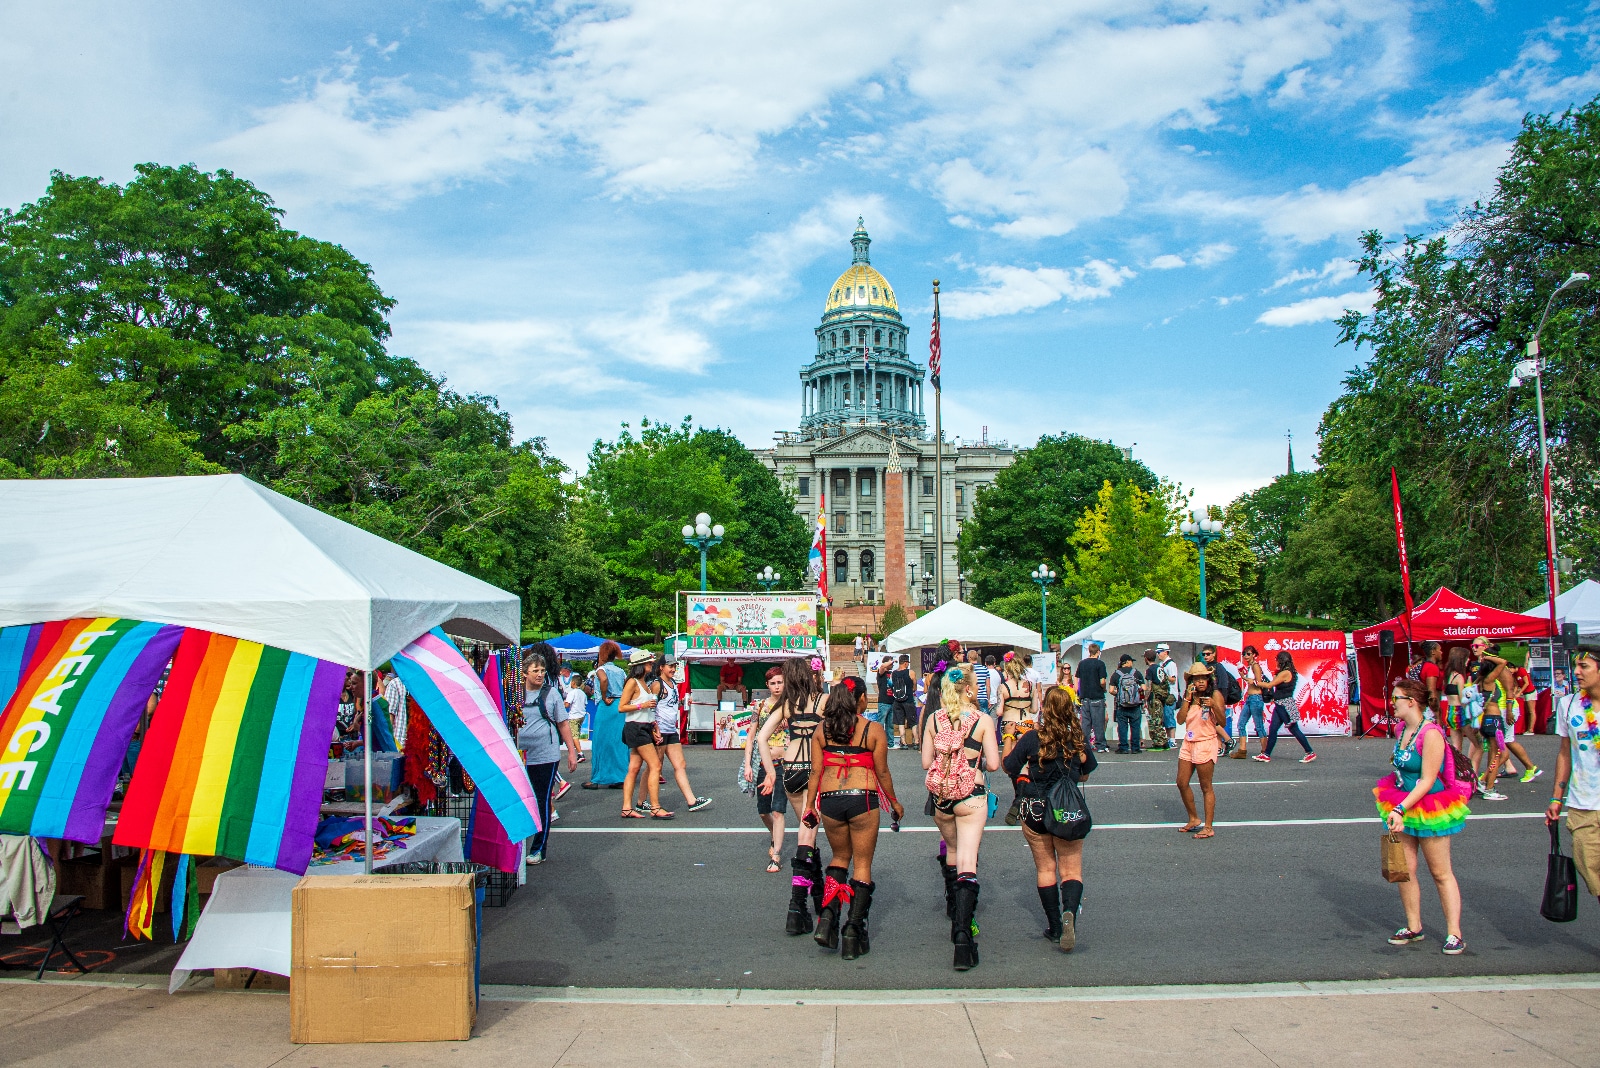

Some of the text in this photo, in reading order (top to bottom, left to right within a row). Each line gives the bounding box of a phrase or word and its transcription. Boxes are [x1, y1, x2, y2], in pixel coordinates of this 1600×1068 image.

[690, 636, 813, 648] ITALIAN ICE
[0, 630, 117, 790] PEACE
